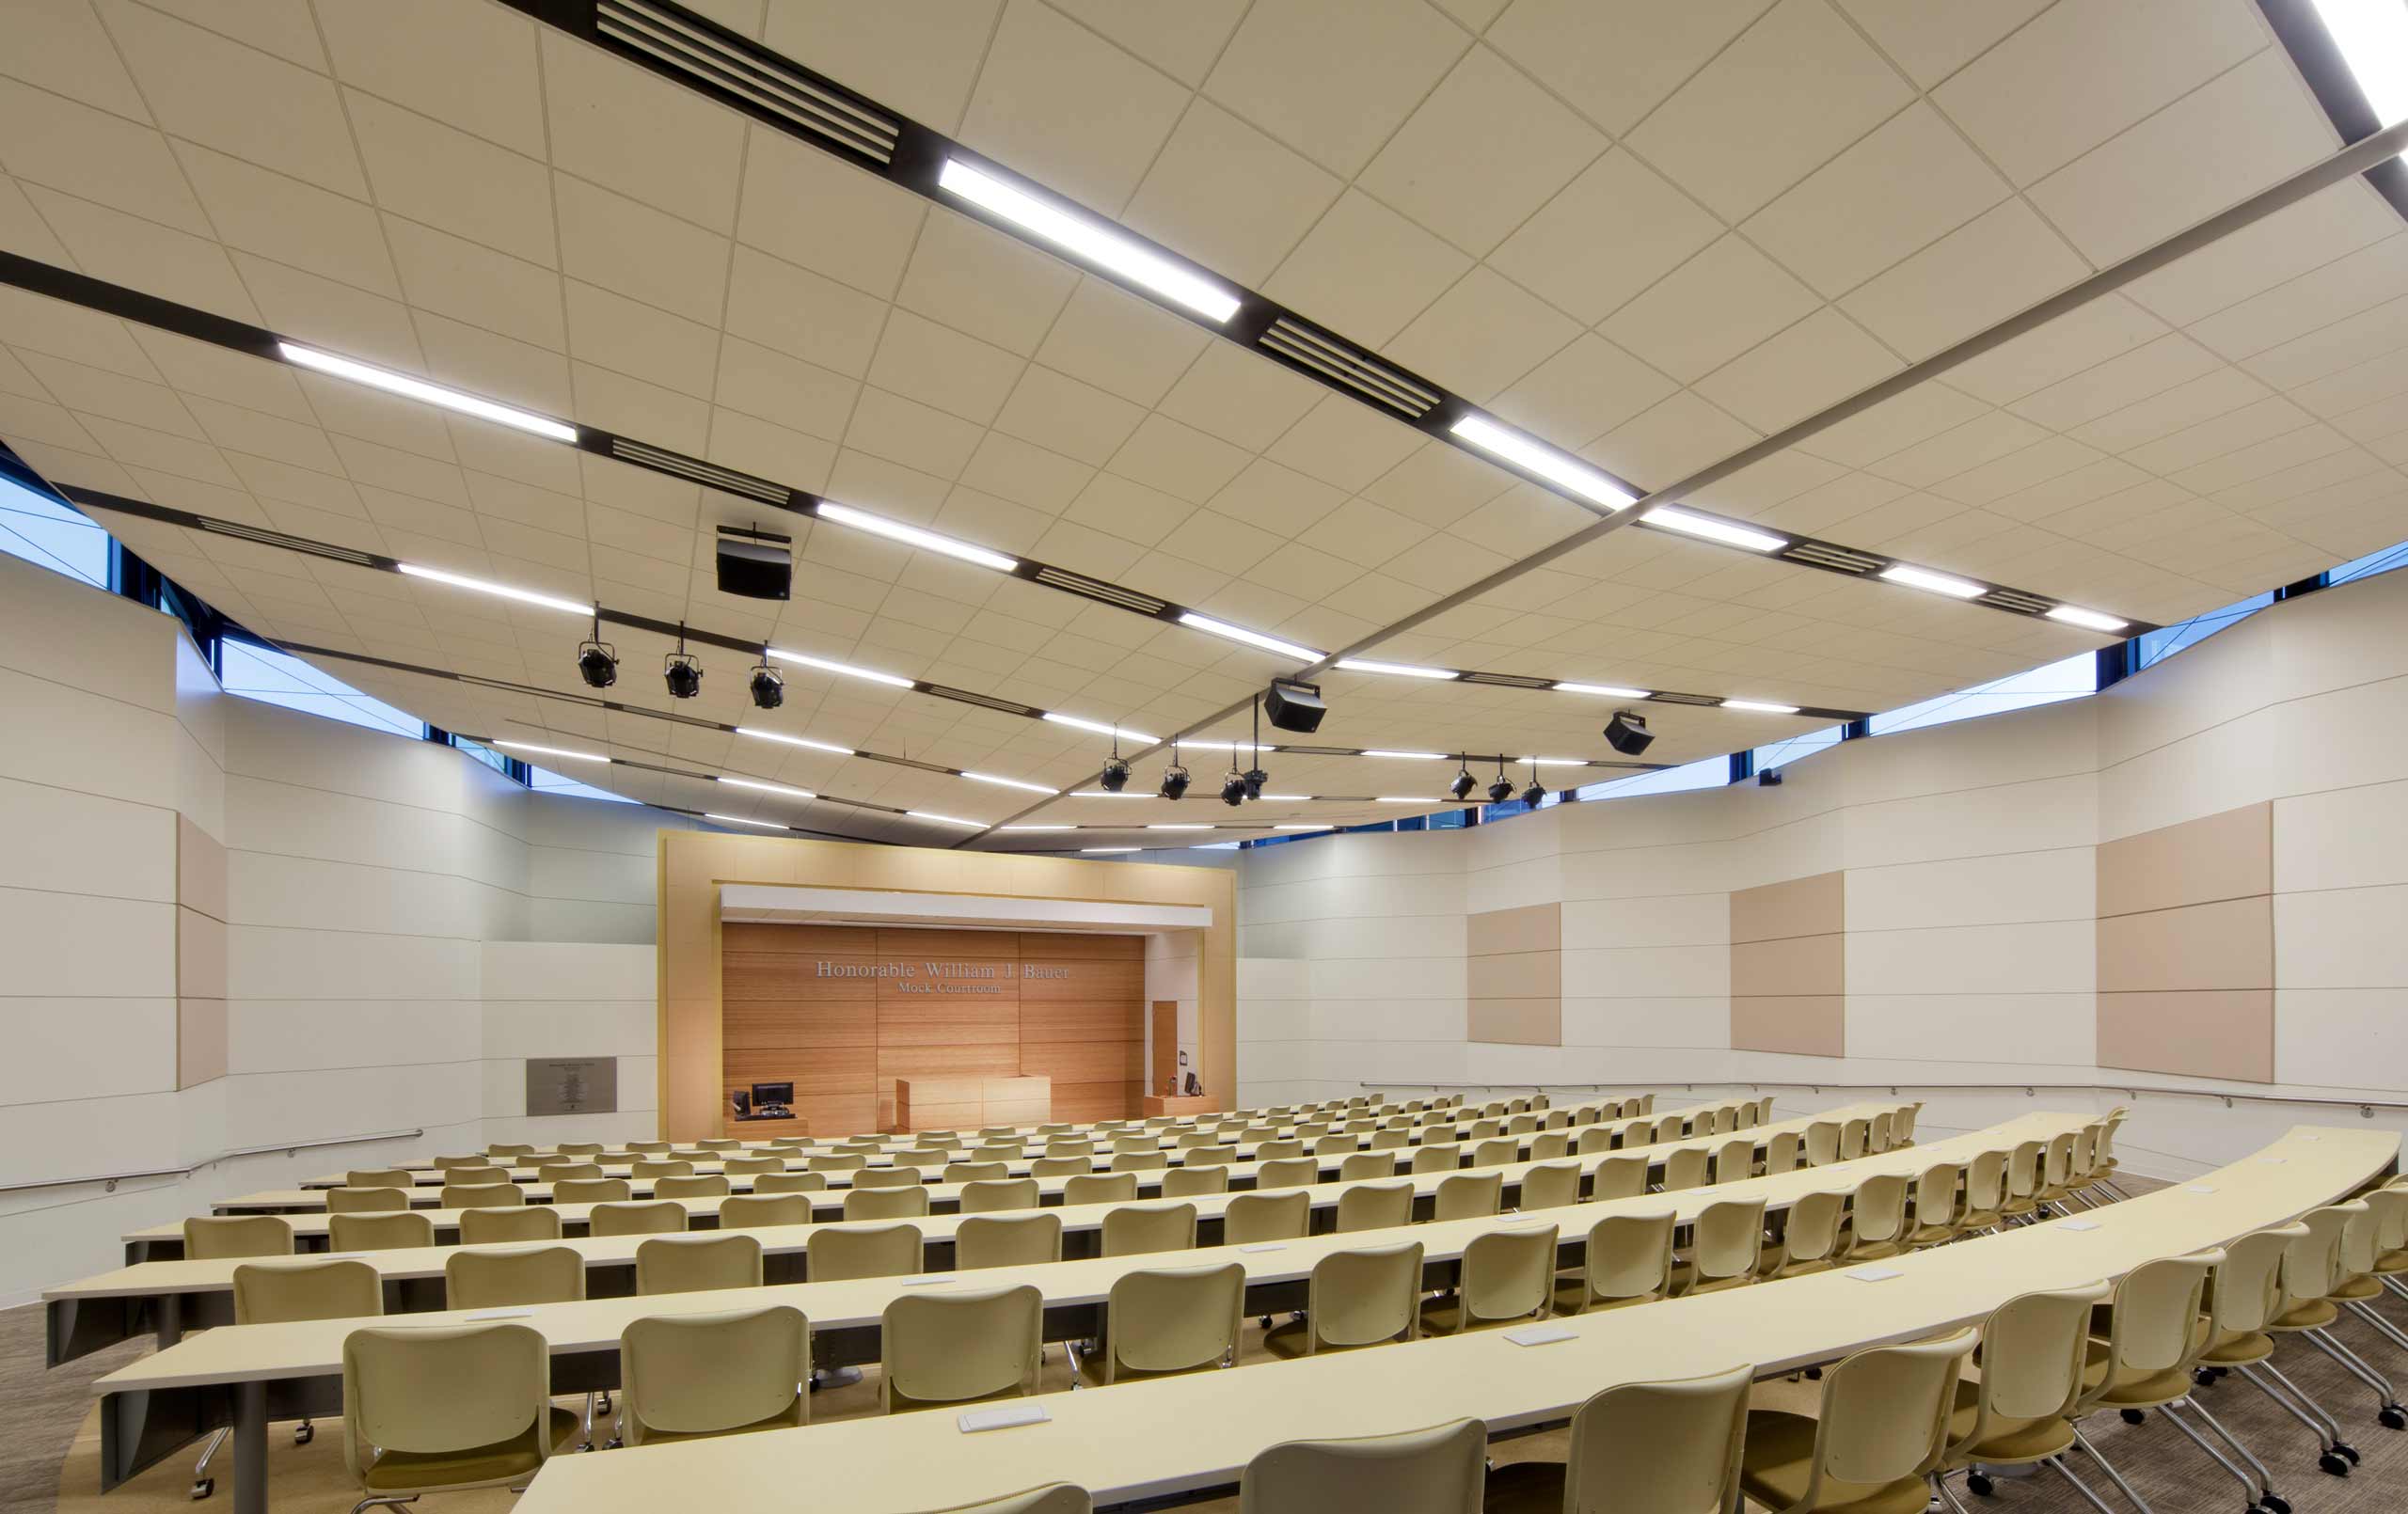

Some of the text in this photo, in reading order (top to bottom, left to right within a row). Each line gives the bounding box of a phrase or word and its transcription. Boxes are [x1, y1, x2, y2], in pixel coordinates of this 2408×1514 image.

[816, 961, 915, 978] Honorable
[925, 962, 994, 978] William
[1023, 964, 1069, 979] Bauer
[897, 982, 1001, 994] Mock Courtroom
